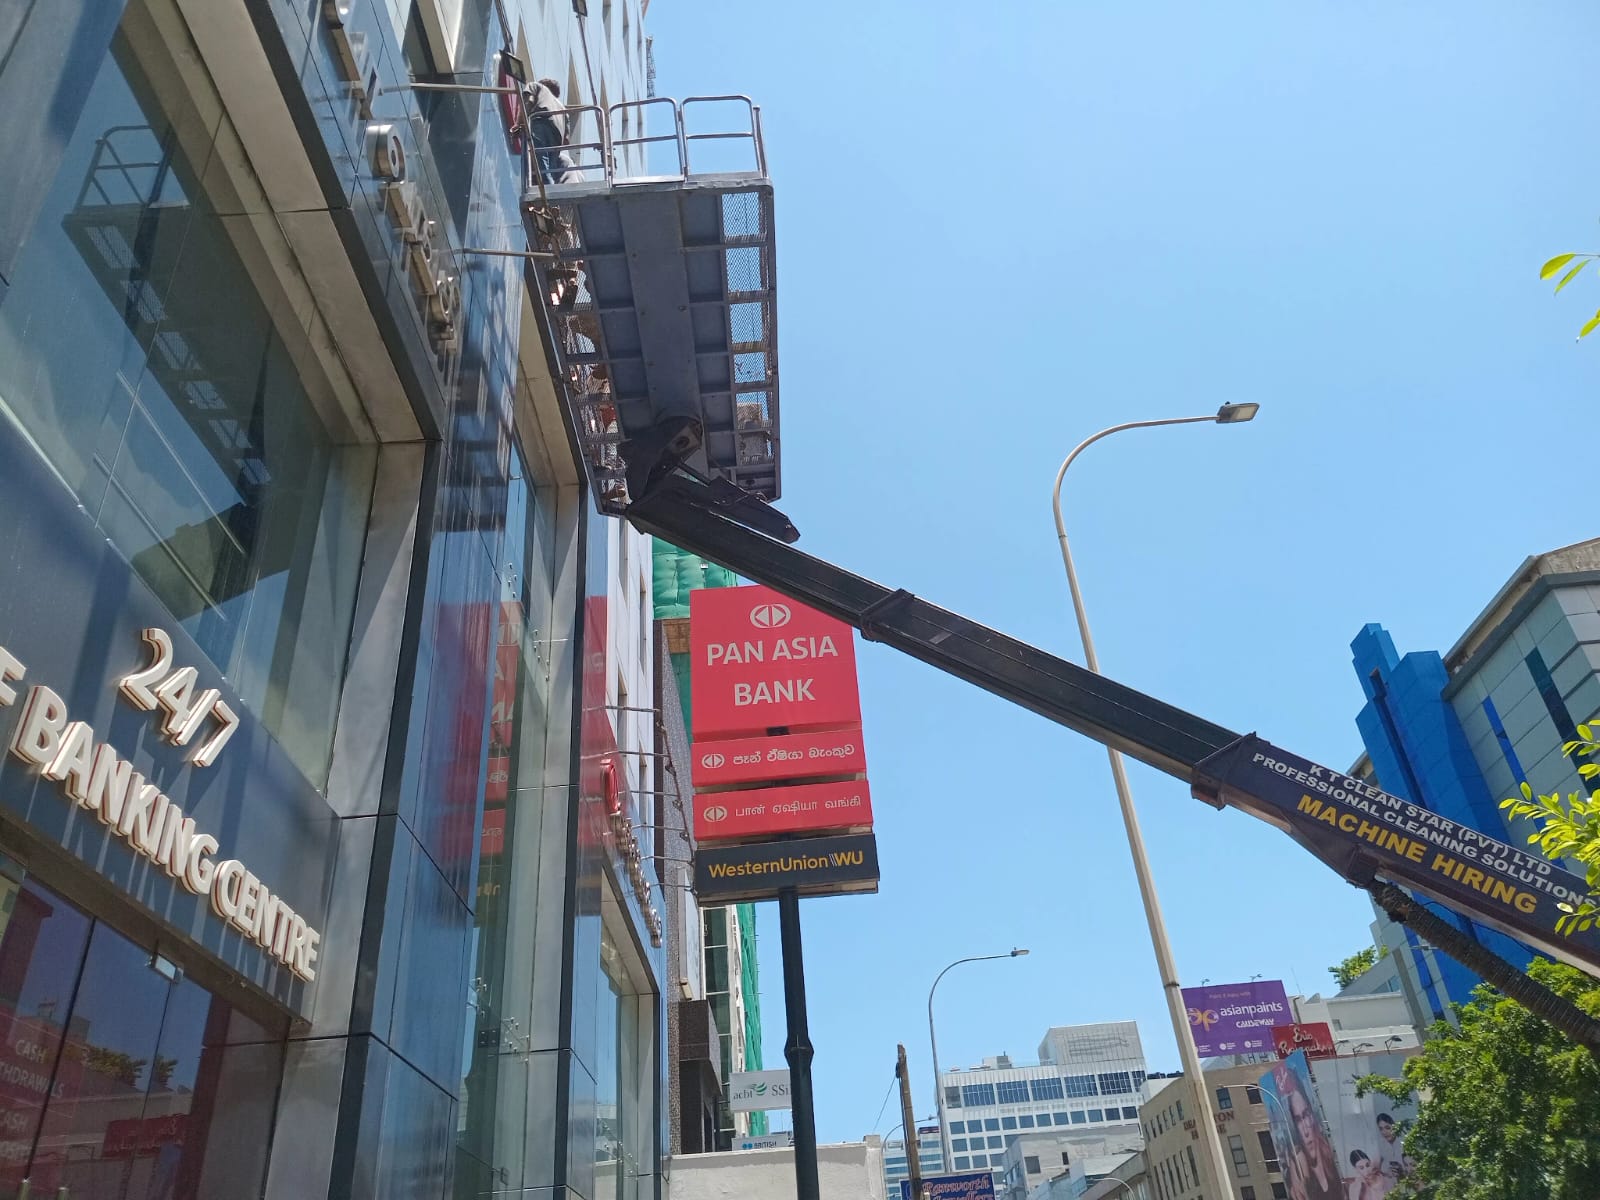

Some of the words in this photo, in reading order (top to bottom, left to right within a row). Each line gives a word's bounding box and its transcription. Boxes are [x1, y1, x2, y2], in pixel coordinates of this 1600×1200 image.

[707, 640, 764, 666] PAN
[772, 635, 839, 661] ASIA
[120, 627, 240, 767] 24/7
[734, 678, 816, 706] BANK
[1252, 753, 1380, 816] PROFESSIONAL
[1383, 811, 1478, 858] CLEANING
[1310, 765, 1323, 777] K
[1329, 771, 1340, 782] T
[1343, 779, 1402, 811] CLEAN
[1406, 806, 1453, 834] STAR
[1458, 827, 1508, 857] (PVT)
[1513, 854, 1551, 876] LTD
[10, 686, 219, 895] BANKING
[211, 859, 320, 983] CENTRE
[835, 851, 864, 867] WU
[1297, 794, 1428, 863] MACHINE
[1431, 853, 1537, 914] HIRING
[1220, 1002, 1283, 1018] asianpaints
[1236, 1018, 1274, 1029] CAUSEWAY
[15, 1039, 47, 1064] CASH
